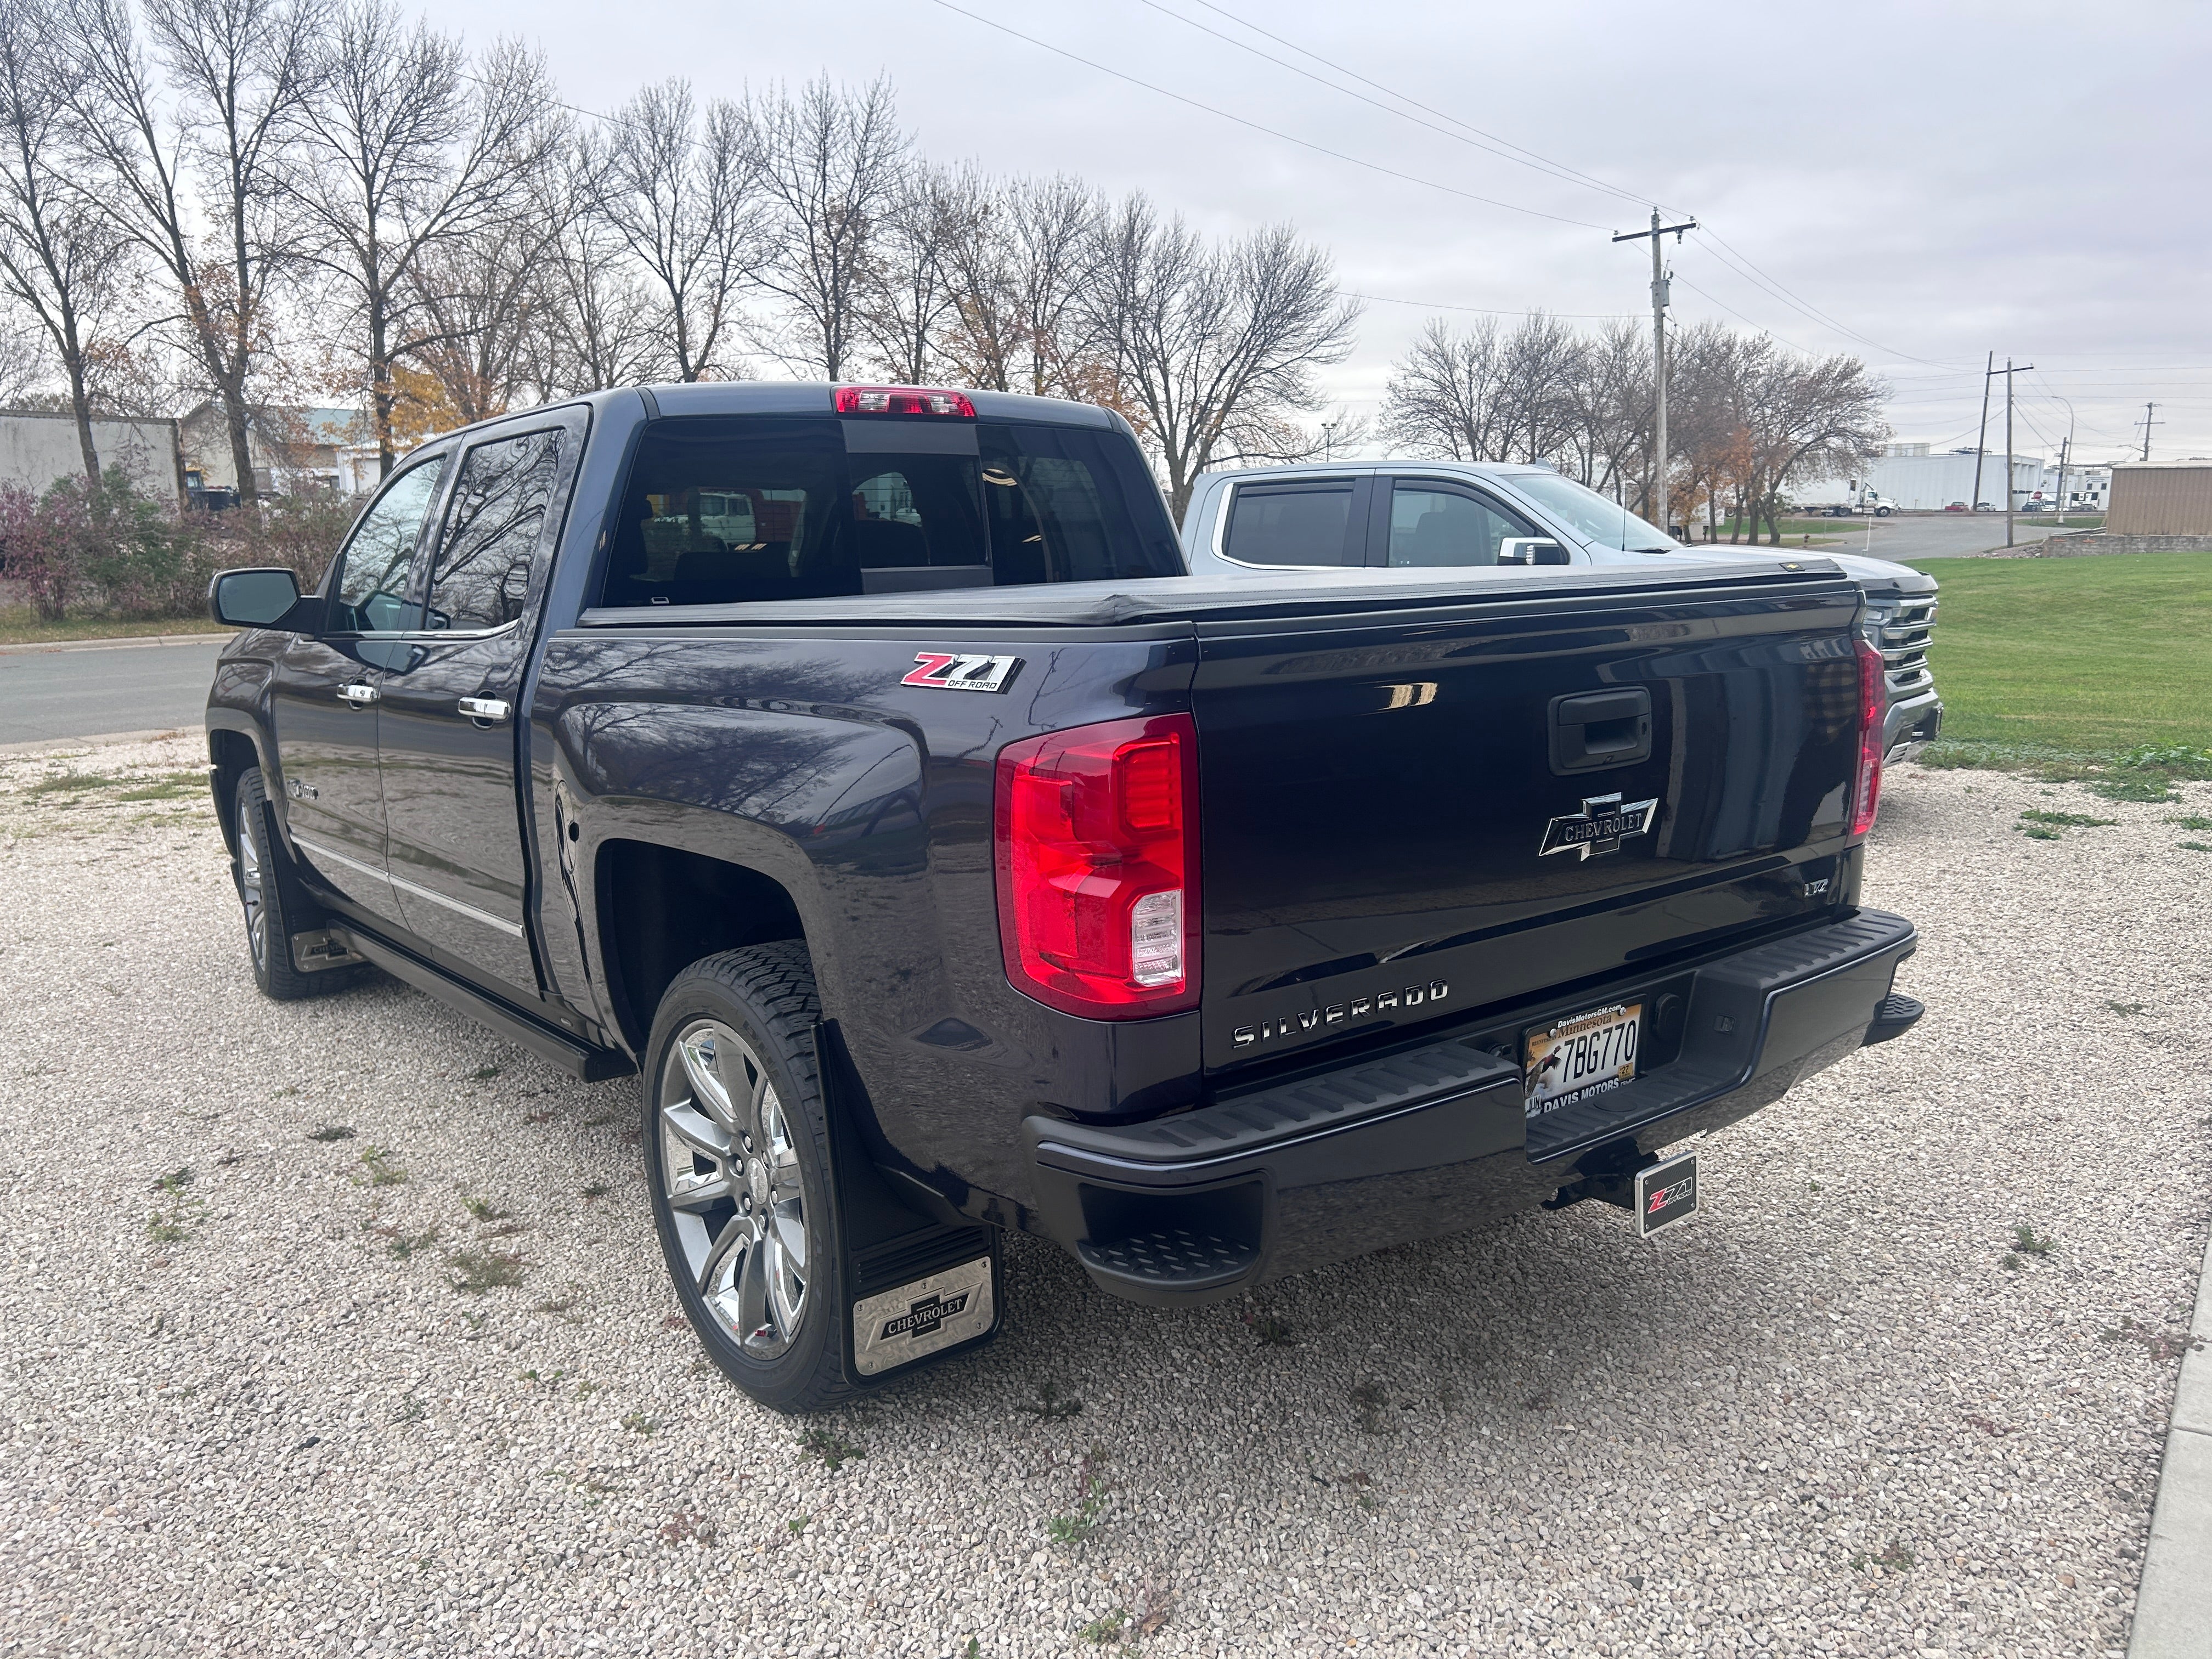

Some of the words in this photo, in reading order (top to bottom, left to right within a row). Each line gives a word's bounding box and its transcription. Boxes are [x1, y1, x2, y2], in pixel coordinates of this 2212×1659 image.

[900, 652, 1015, 687] Z71
[1565, 813, 1641, 842] CHEVROLET
[1803, 878, 1828, 898] LTZ
[1232, 979, 1449, 1049] SILVERADO
[1558, 1005, 1622, 1028] DavisMotorsGM.com
[1559, 1014, 1612, 1038] Minnesota
[1563, 1020, 1636, 1083] 7BG770
[1622, 1065, 1629, 1074] 27
[1544, 1092, 1578, 1113] DAVIS
[1581, 1077, 1619, 1101] MOTORS
[1647, 1176, 1692, 1214] Z71
[888, 1299, 962, 1334] CHEVROLET
